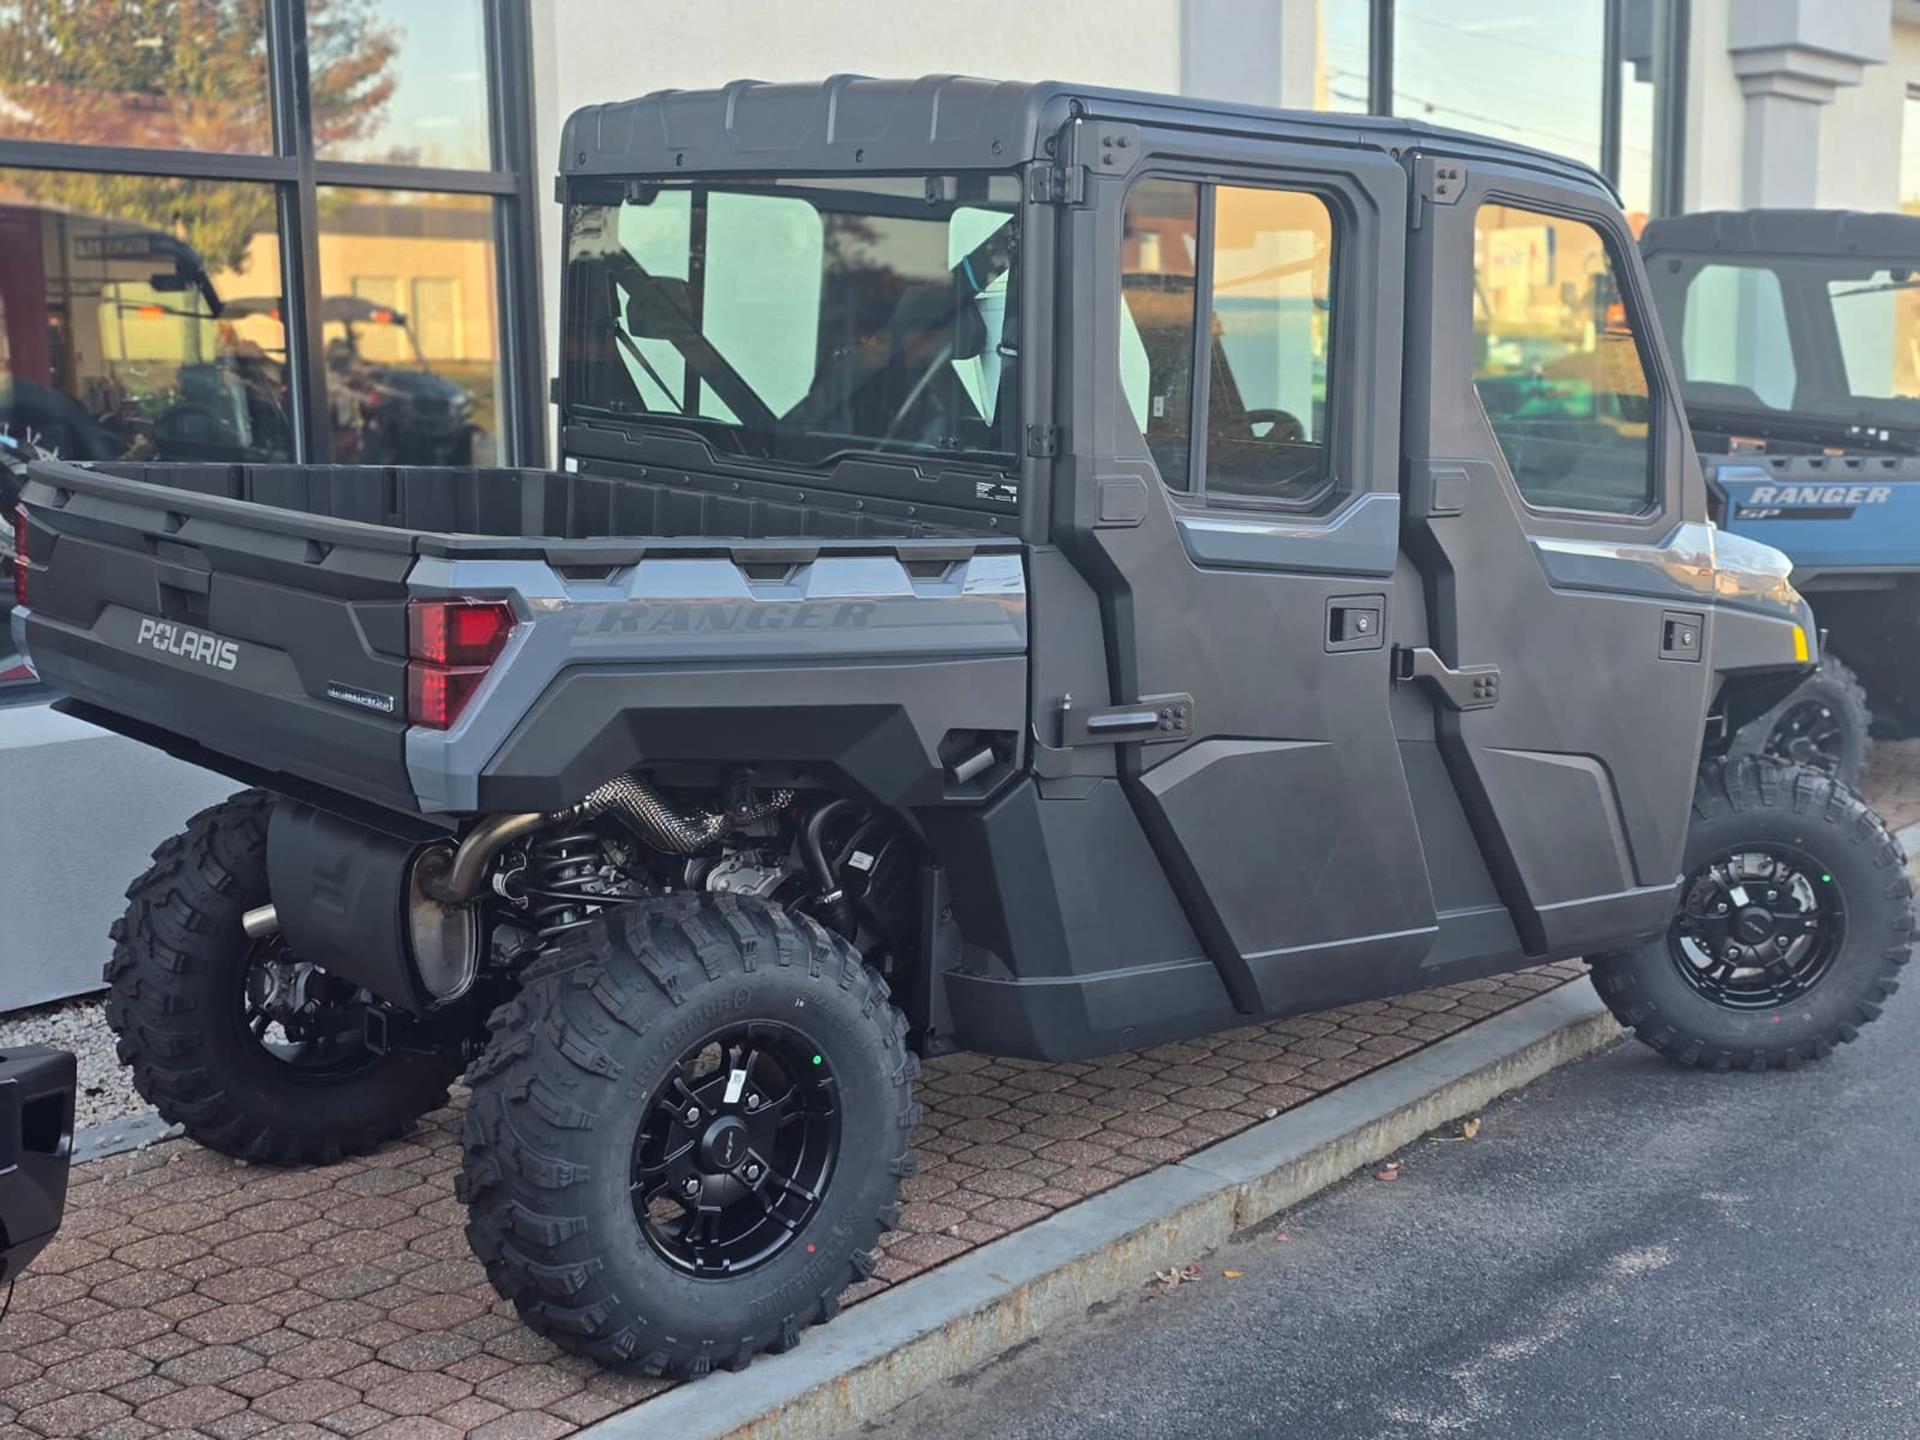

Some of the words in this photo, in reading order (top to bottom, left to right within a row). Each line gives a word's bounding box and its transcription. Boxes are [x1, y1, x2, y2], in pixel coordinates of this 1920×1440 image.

[1749, 486, 1892, 505] RANGER
[593, 601, 879, 634] RANGER
[137, 618, 239, 671] POLARIS
